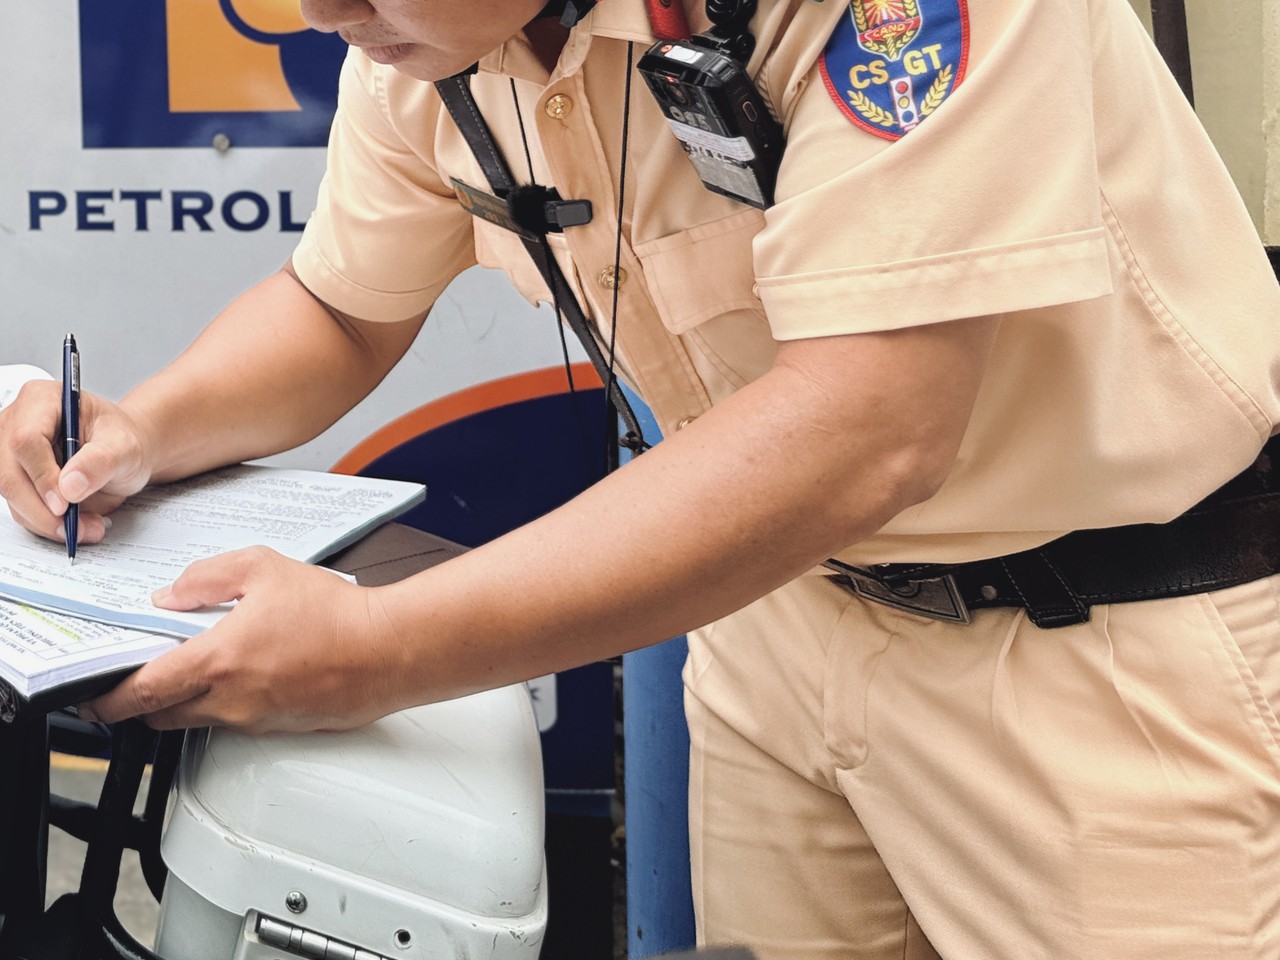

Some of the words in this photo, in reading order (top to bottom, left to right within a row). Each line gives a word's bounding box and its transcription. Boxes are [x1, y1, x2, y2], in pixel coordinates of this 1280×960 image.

[873, 23, 906, 37] CAND
[849, 60, 889, 89] CS
[903, 43, 942, 76] GT
